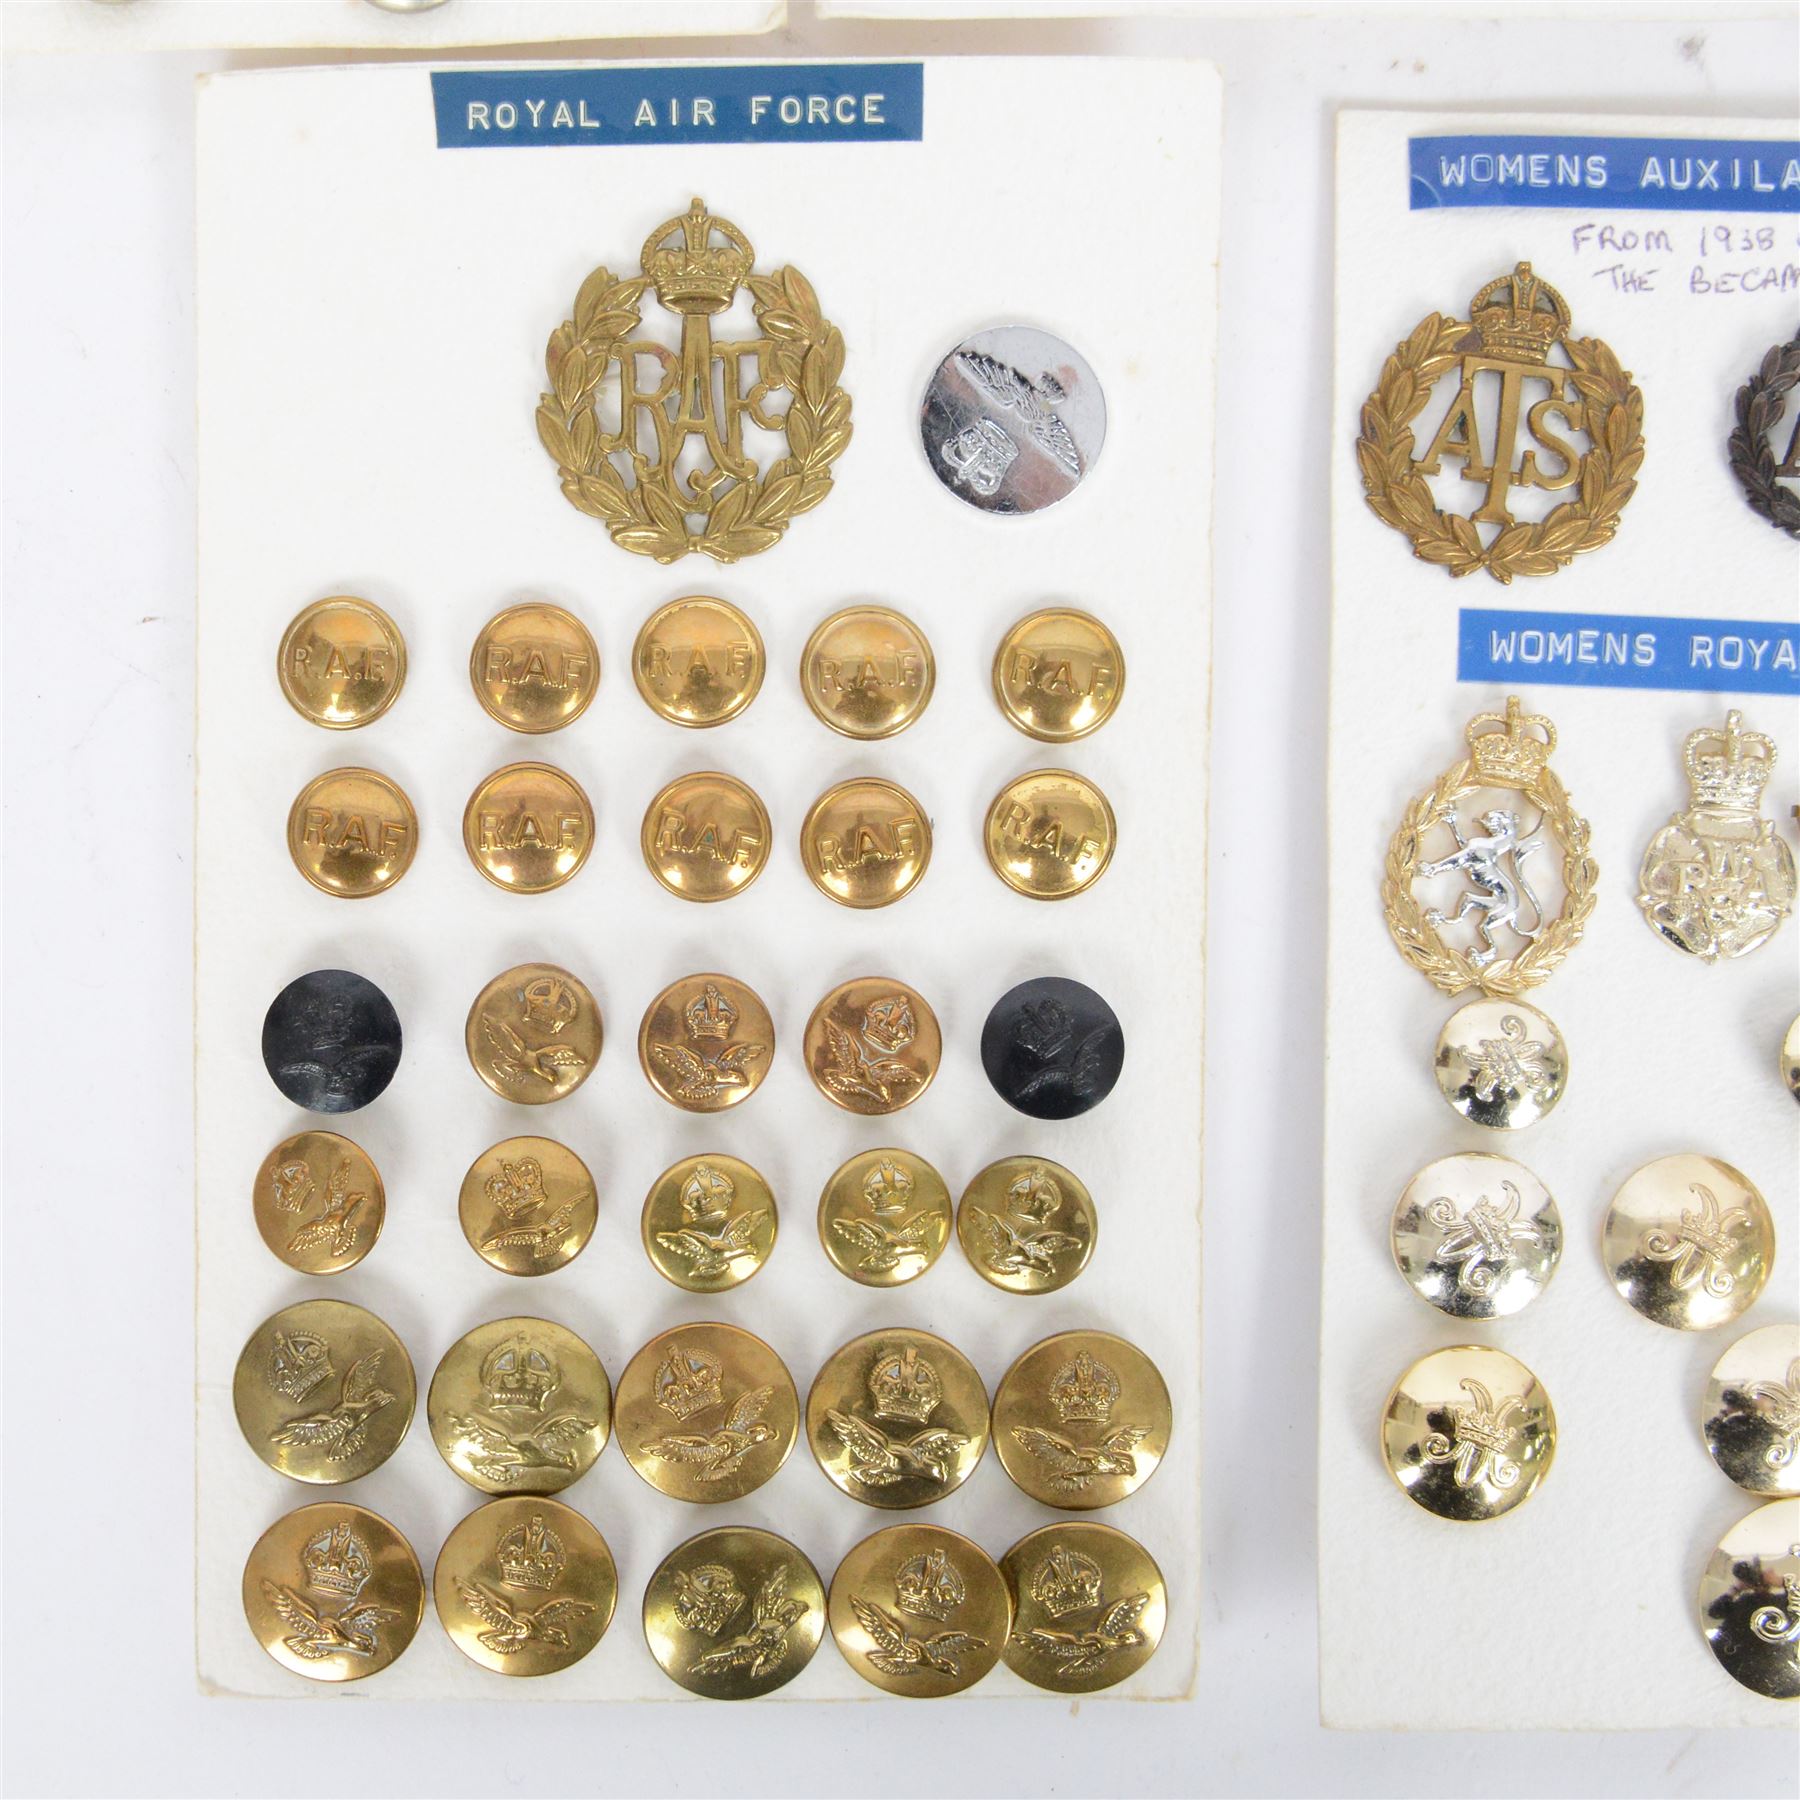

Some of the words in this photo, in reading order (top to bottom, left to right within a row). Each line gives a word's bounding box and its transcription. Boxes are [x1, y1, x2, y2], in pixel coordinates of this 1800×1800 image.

[467, 99, 601, 131] ROYAL
[634, 98, 716, 127] AIR
[750, 94, 886, 125] FORCE
[1440, 154, 1608, 188] WOMENS
[1572, 224, 1674, 255] FROM
[1700, 225, 1775, 257] 1938
[1593, 264, 1661, 293] THE
[1490, 629, 1657, 667] WOMENS
